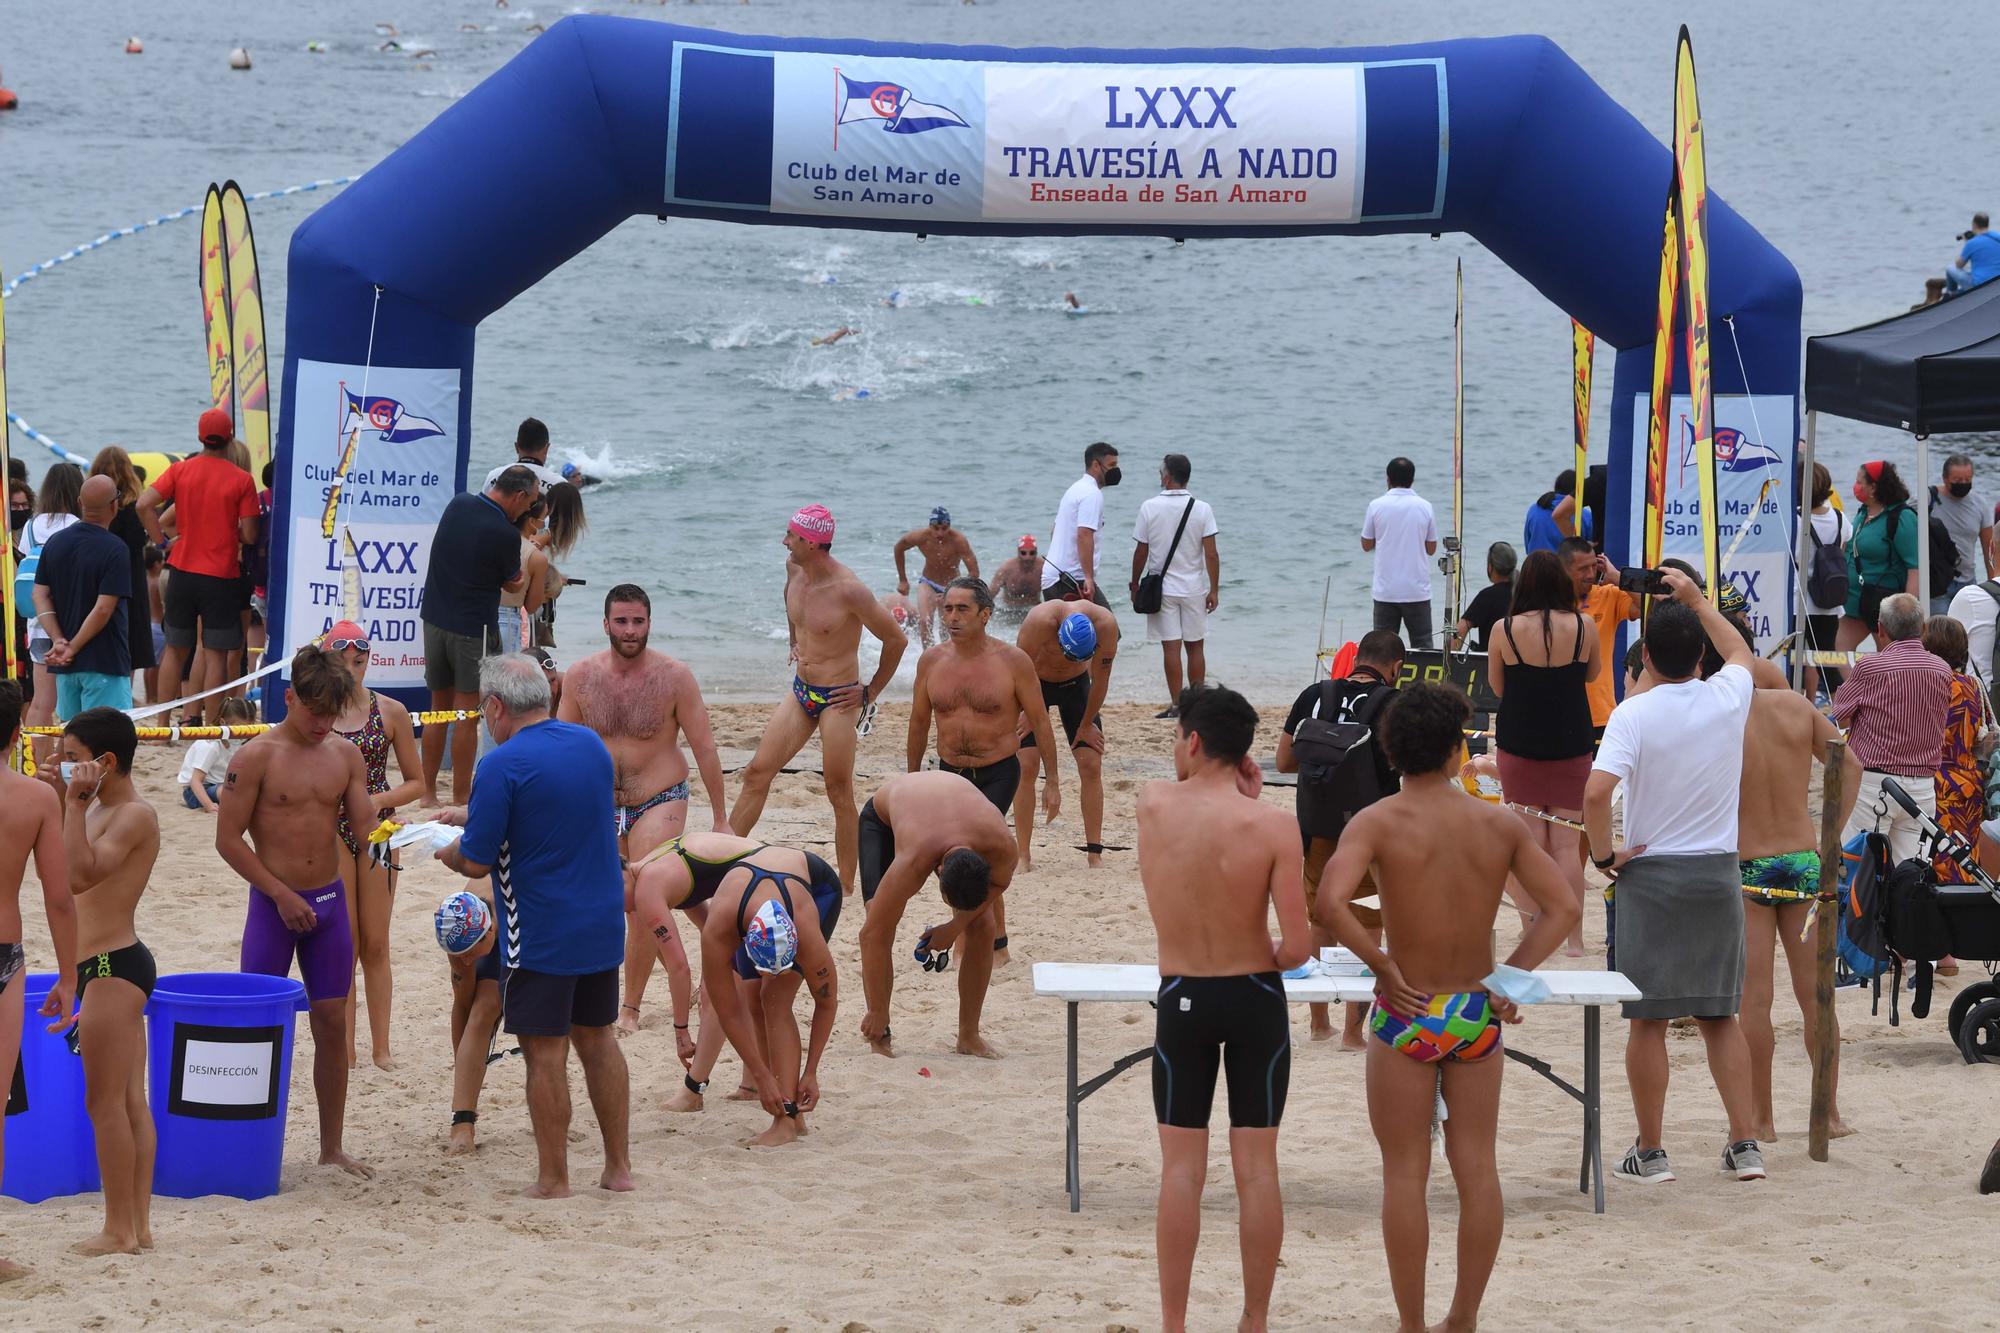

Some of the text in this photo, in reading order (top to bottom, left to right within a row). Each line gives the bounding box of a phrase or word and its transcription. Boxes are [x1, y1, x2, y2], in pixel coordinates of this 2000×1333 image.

[1105, 86, 1237, 129] LXXX
[1003, 141, 1337, 179] TRAVESÍA A NADO
[788, 162, 961, 186] Club del Mar de
[813, 185, 934, 205] San Amaro
[1030, 182, 1307, 203] Enseada de San Amaro
[381, 470, 418, 486] Mar
[421, 471, 439, 487] de
[360, 490, 420, 507] Amaro
[1762, 499, 1778, 515] de
[1664, 520, 1698, 536] San
[364, 619, 416, 642] ADO
[371, 653, 426, 666] San Ama
[315, 891, 337, 903] arena
[189, 1064, 258, 1076] DESINFECCIÓN
